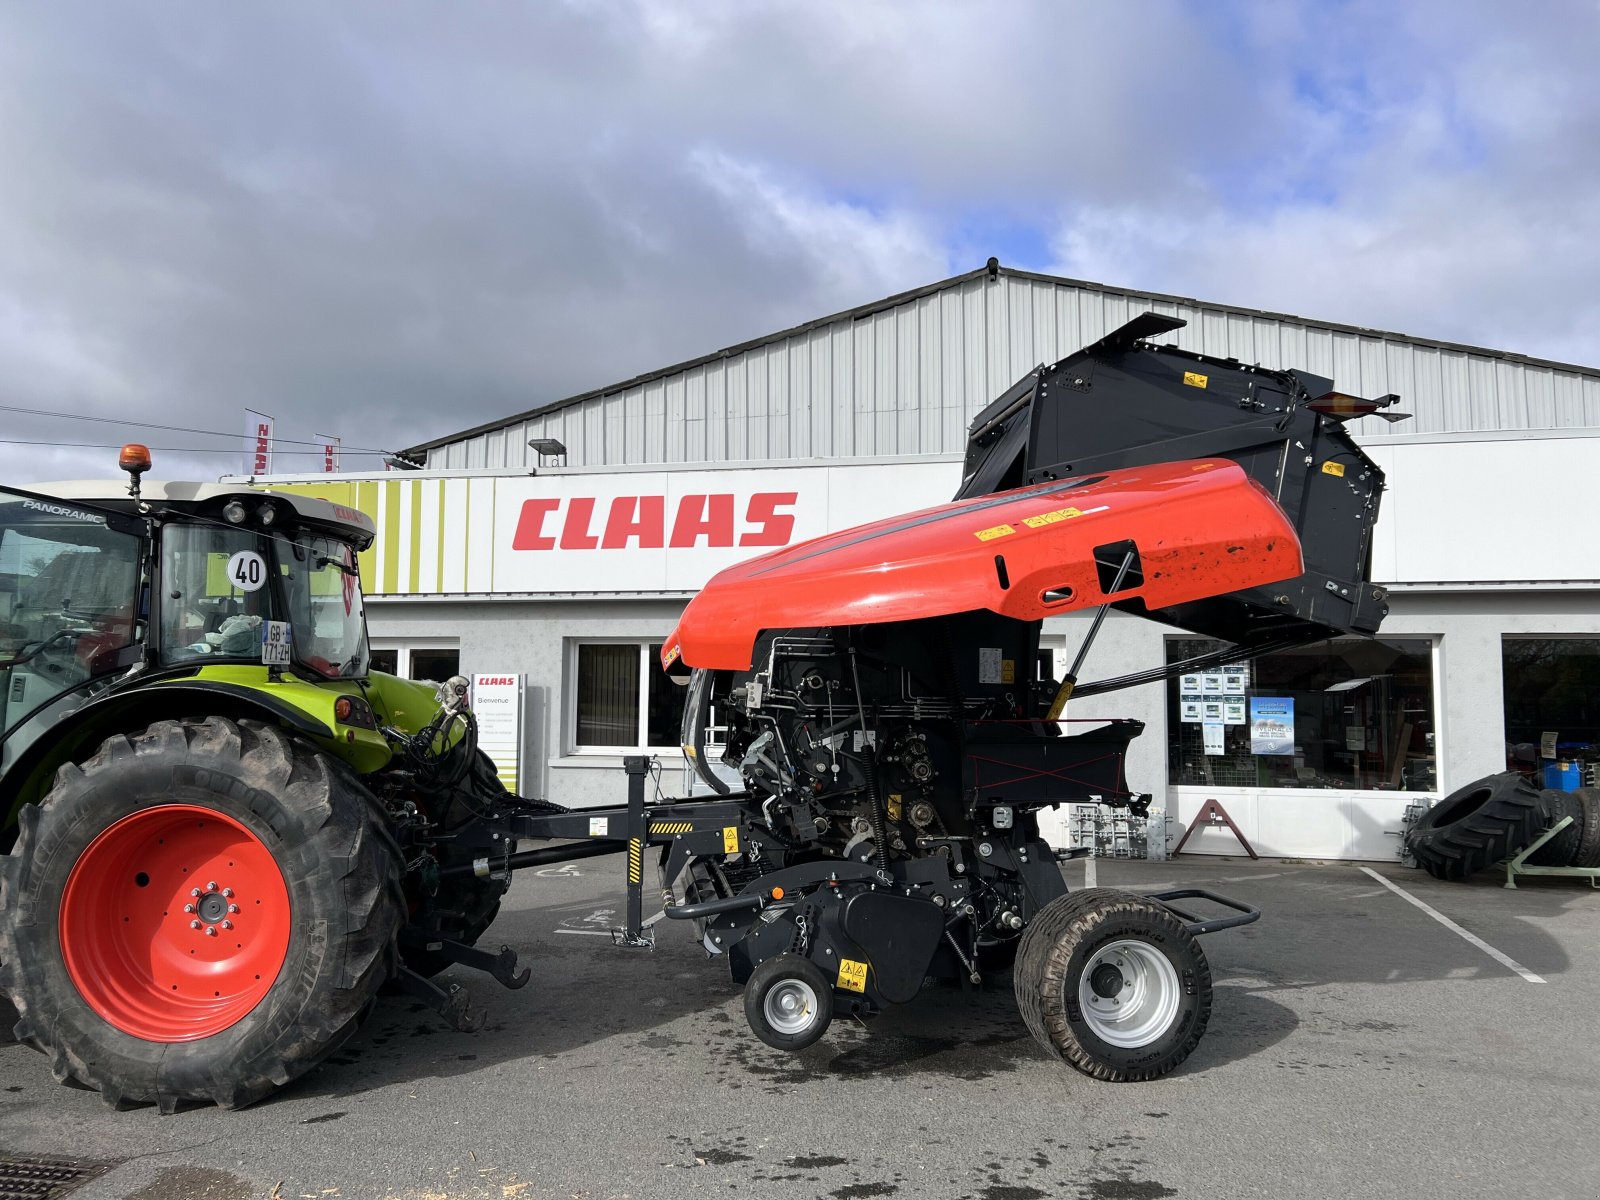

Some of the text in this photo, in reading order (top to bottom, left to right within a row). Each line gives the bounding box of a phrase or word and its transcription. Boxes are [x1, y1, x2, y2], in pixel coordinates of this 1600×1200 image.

[22, 500, 104, 523] PANORAMIC
[512, 492, 798, 551] CLAAS
[235, 557, 260, 584] 40
[479, 677, 515, 685] CLAAS
